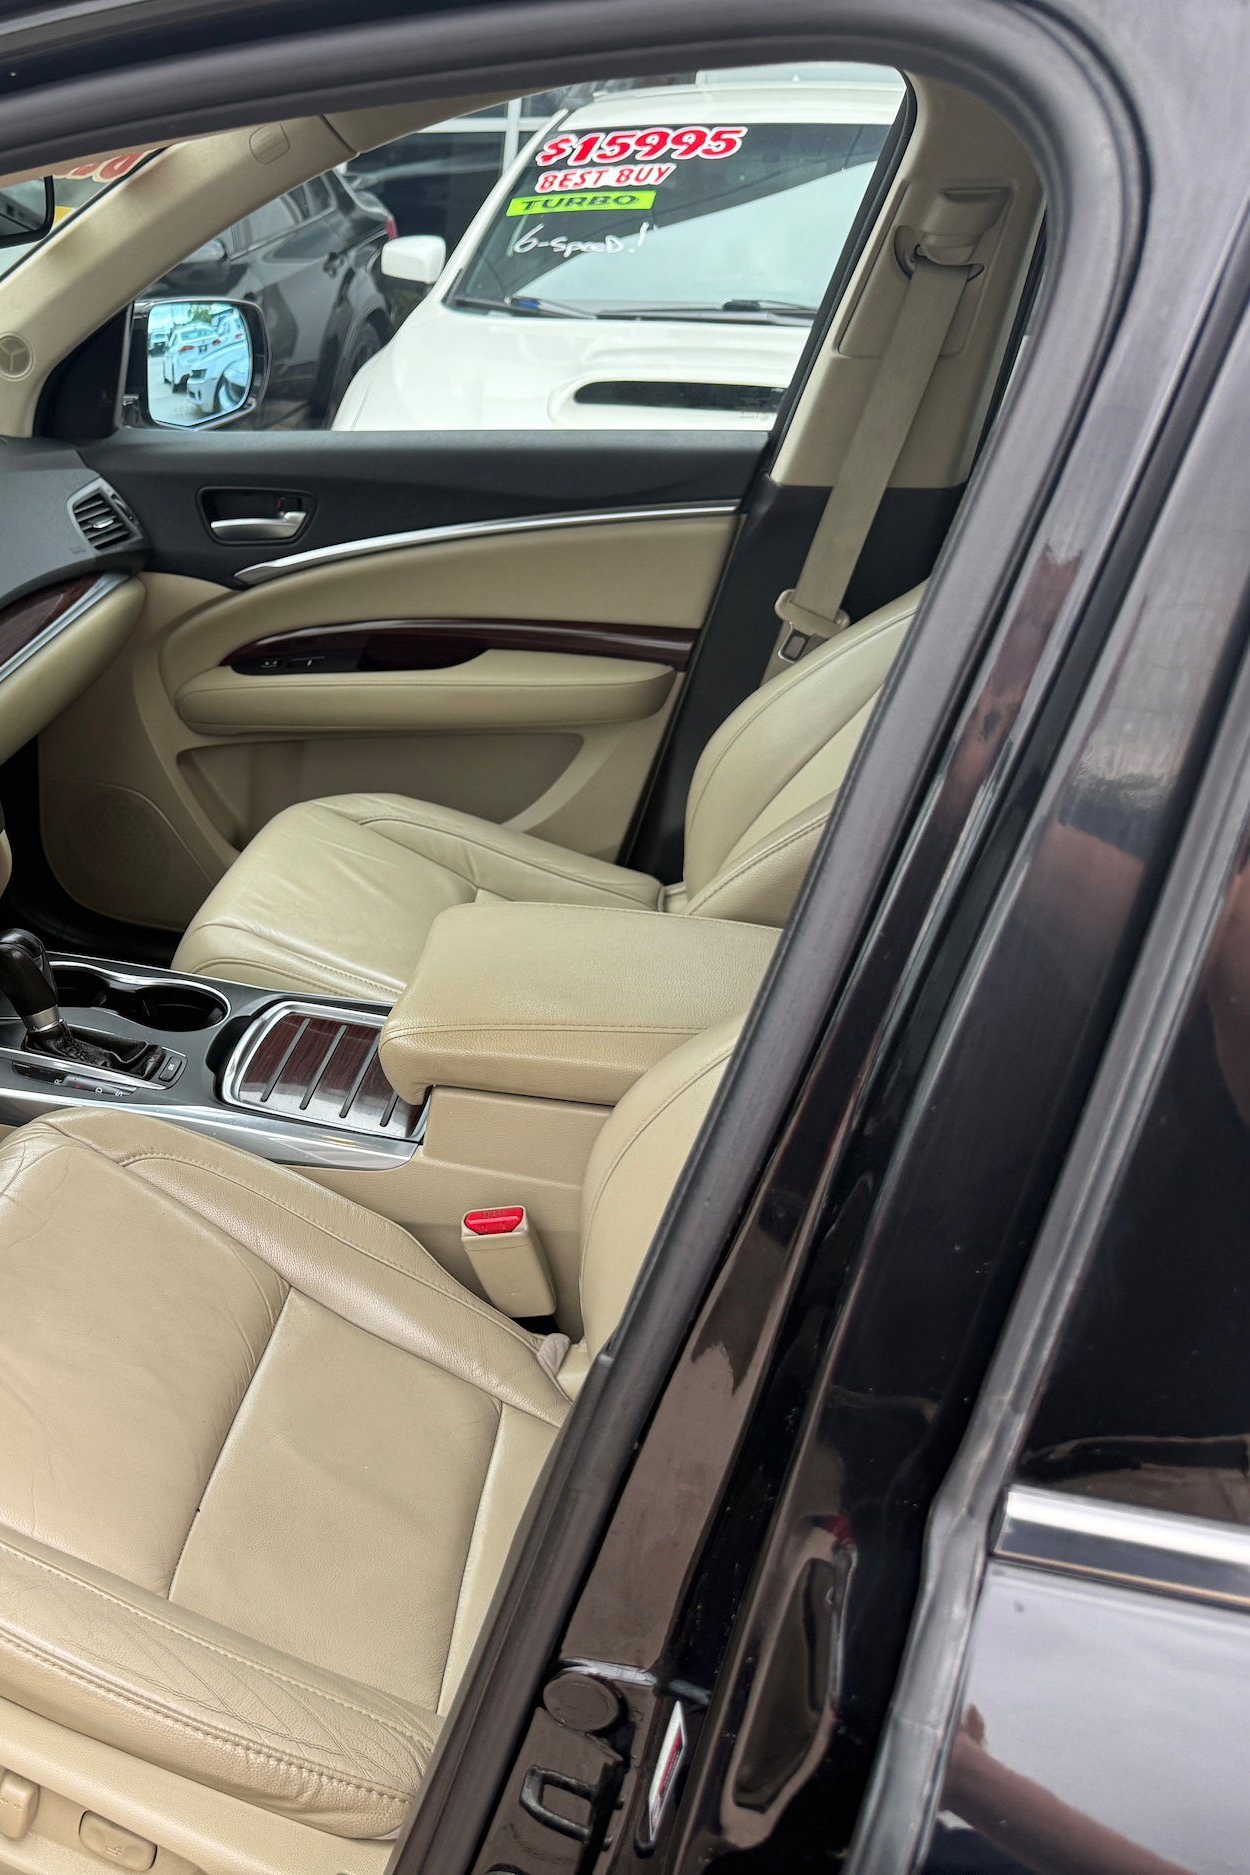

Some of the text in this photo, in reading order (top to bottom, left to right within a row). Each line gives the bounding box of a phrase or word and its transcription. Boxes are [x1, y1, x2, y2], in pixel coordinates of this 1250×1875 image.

[536, 127, 748, 166] $15995
[537, 163, 677, 193] BEST BUY
[522, 194, 640, 212] TURBO
